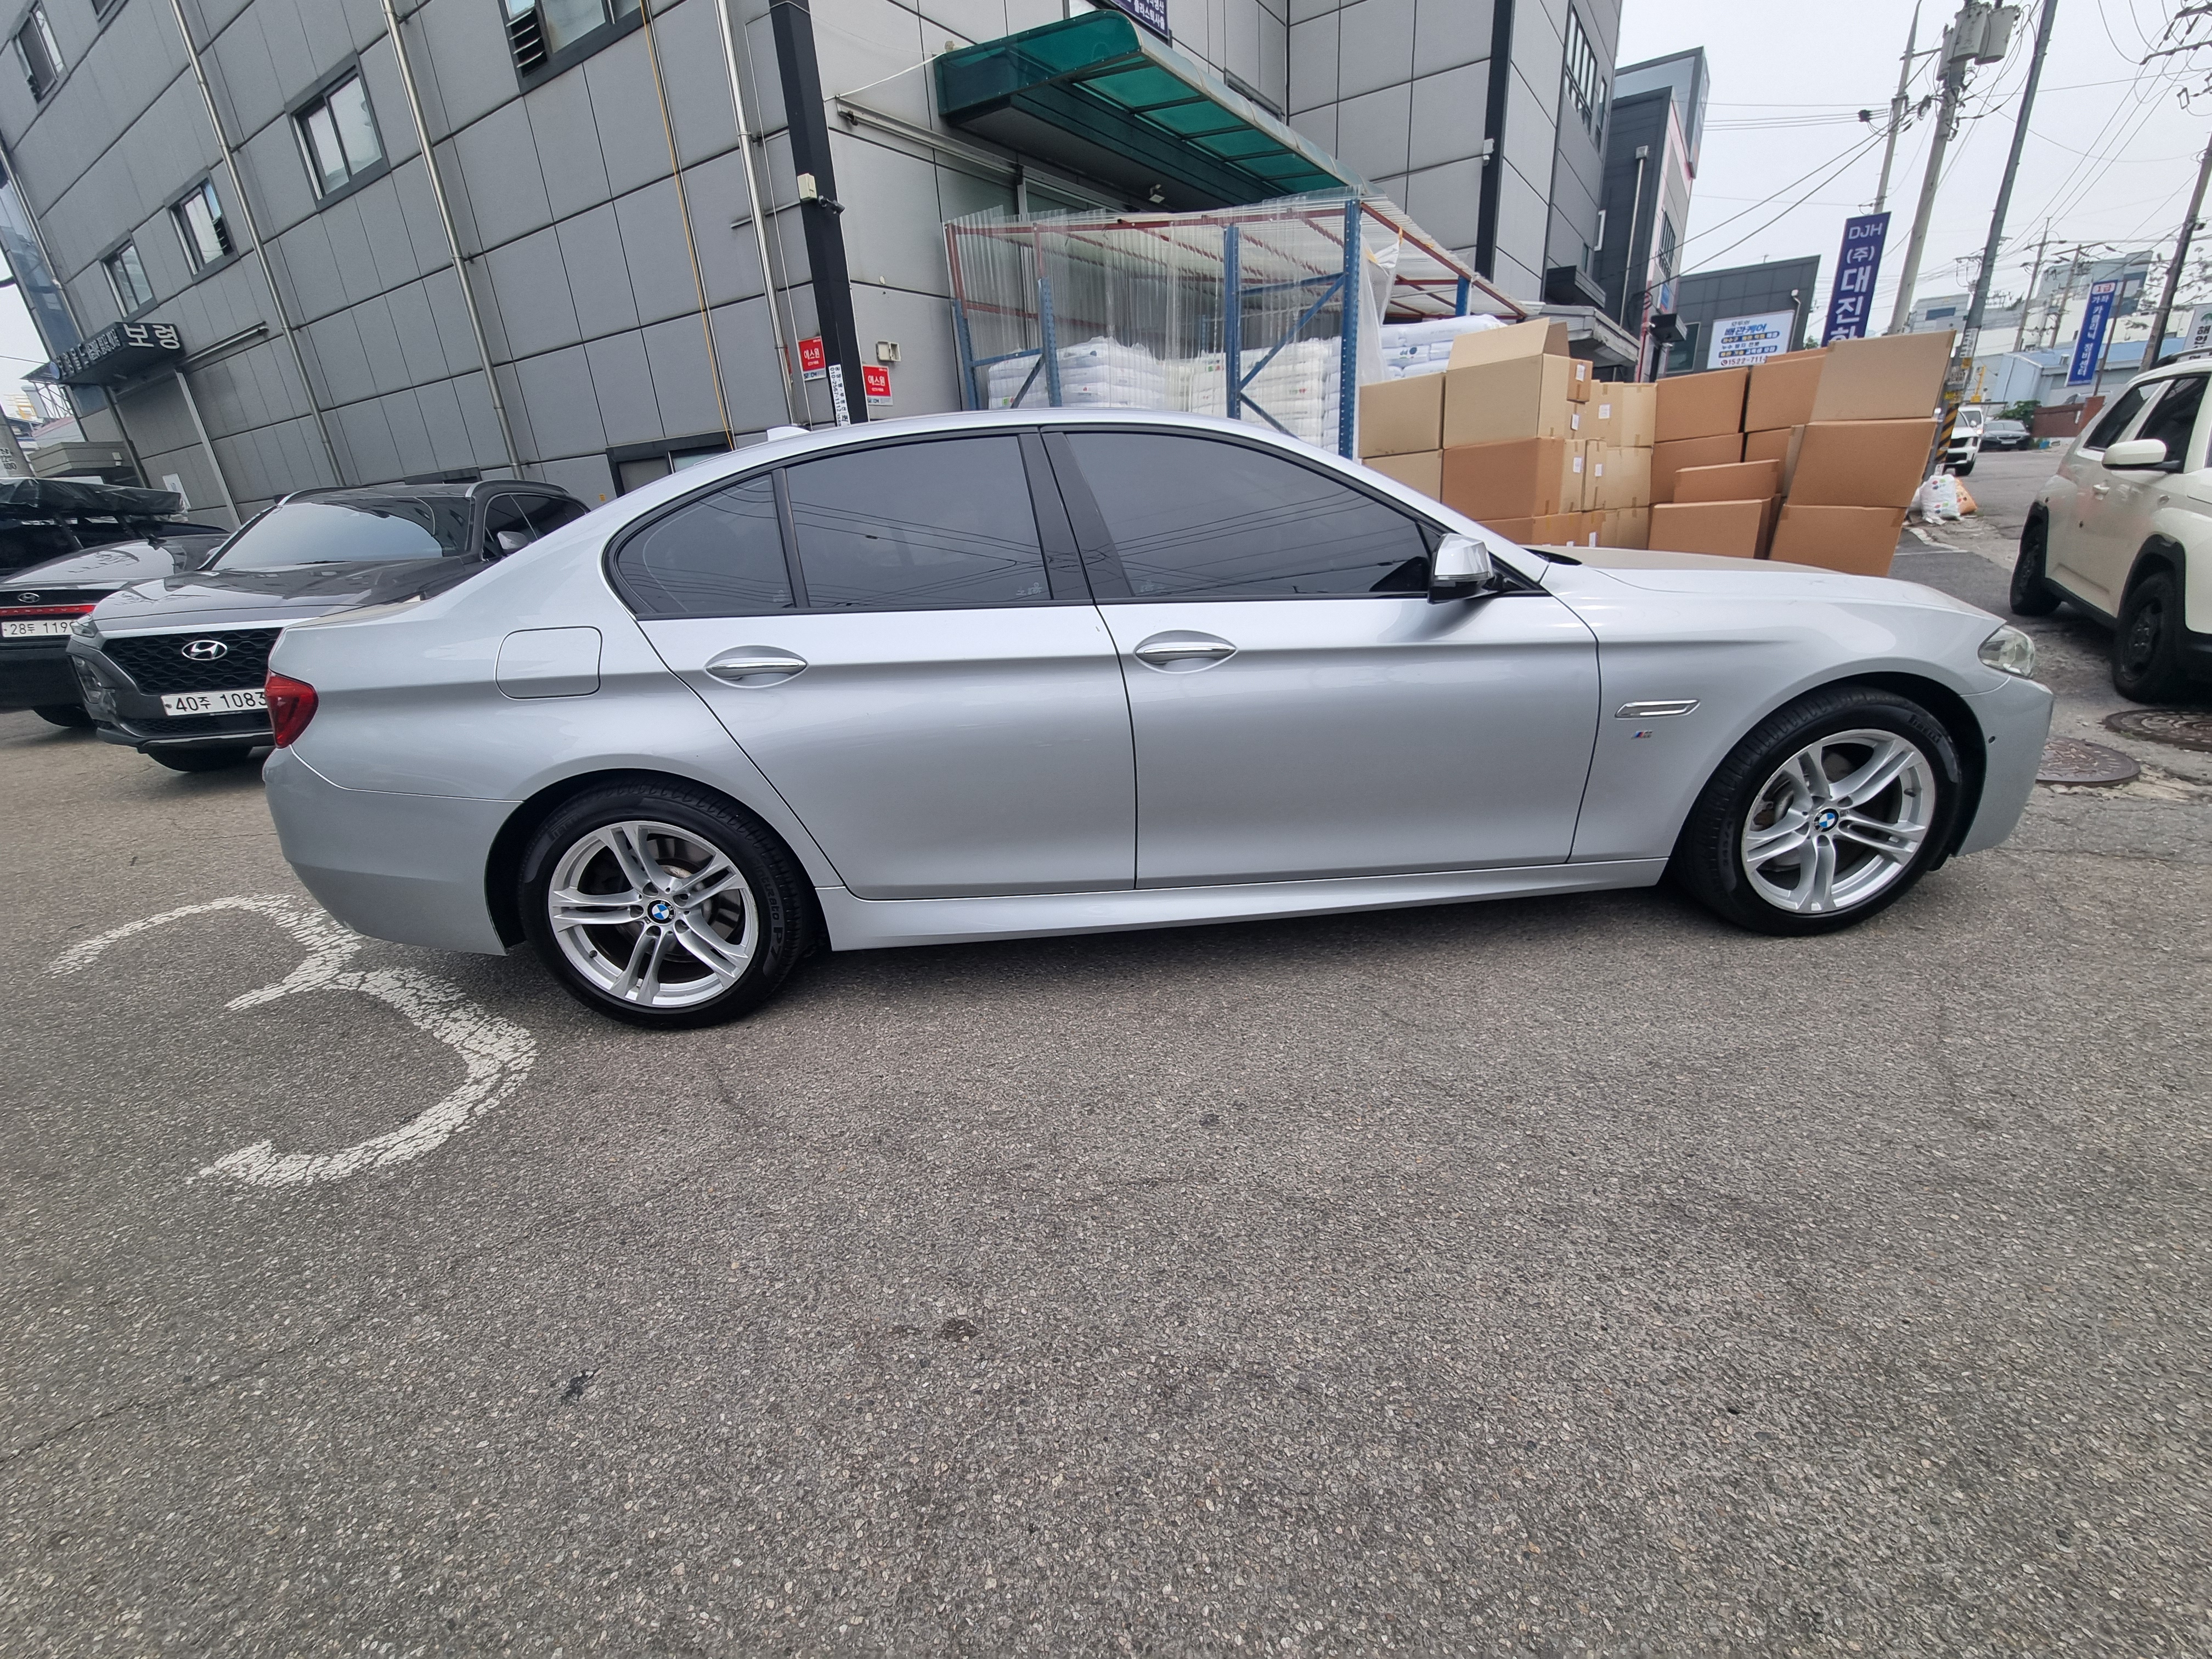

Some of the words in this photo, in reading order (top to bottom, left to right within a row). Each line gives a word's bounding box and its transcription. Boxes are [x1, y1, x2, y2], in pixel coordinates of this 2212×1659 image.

[1848, 222, 1883, 239] DJH
[1846, 246, 1875, 264] (주)
[123, 323, 180, 349] 보령
[1724, 324, 1767, 335] 배관케어
[804, 348, 820, 360] 에스원
[868, 375, 885, 386] 에스원
[10, 623, 35, 635] 28두
[176, 697, 211, 712] 40주
[220, 692, 267, 708] 1083
